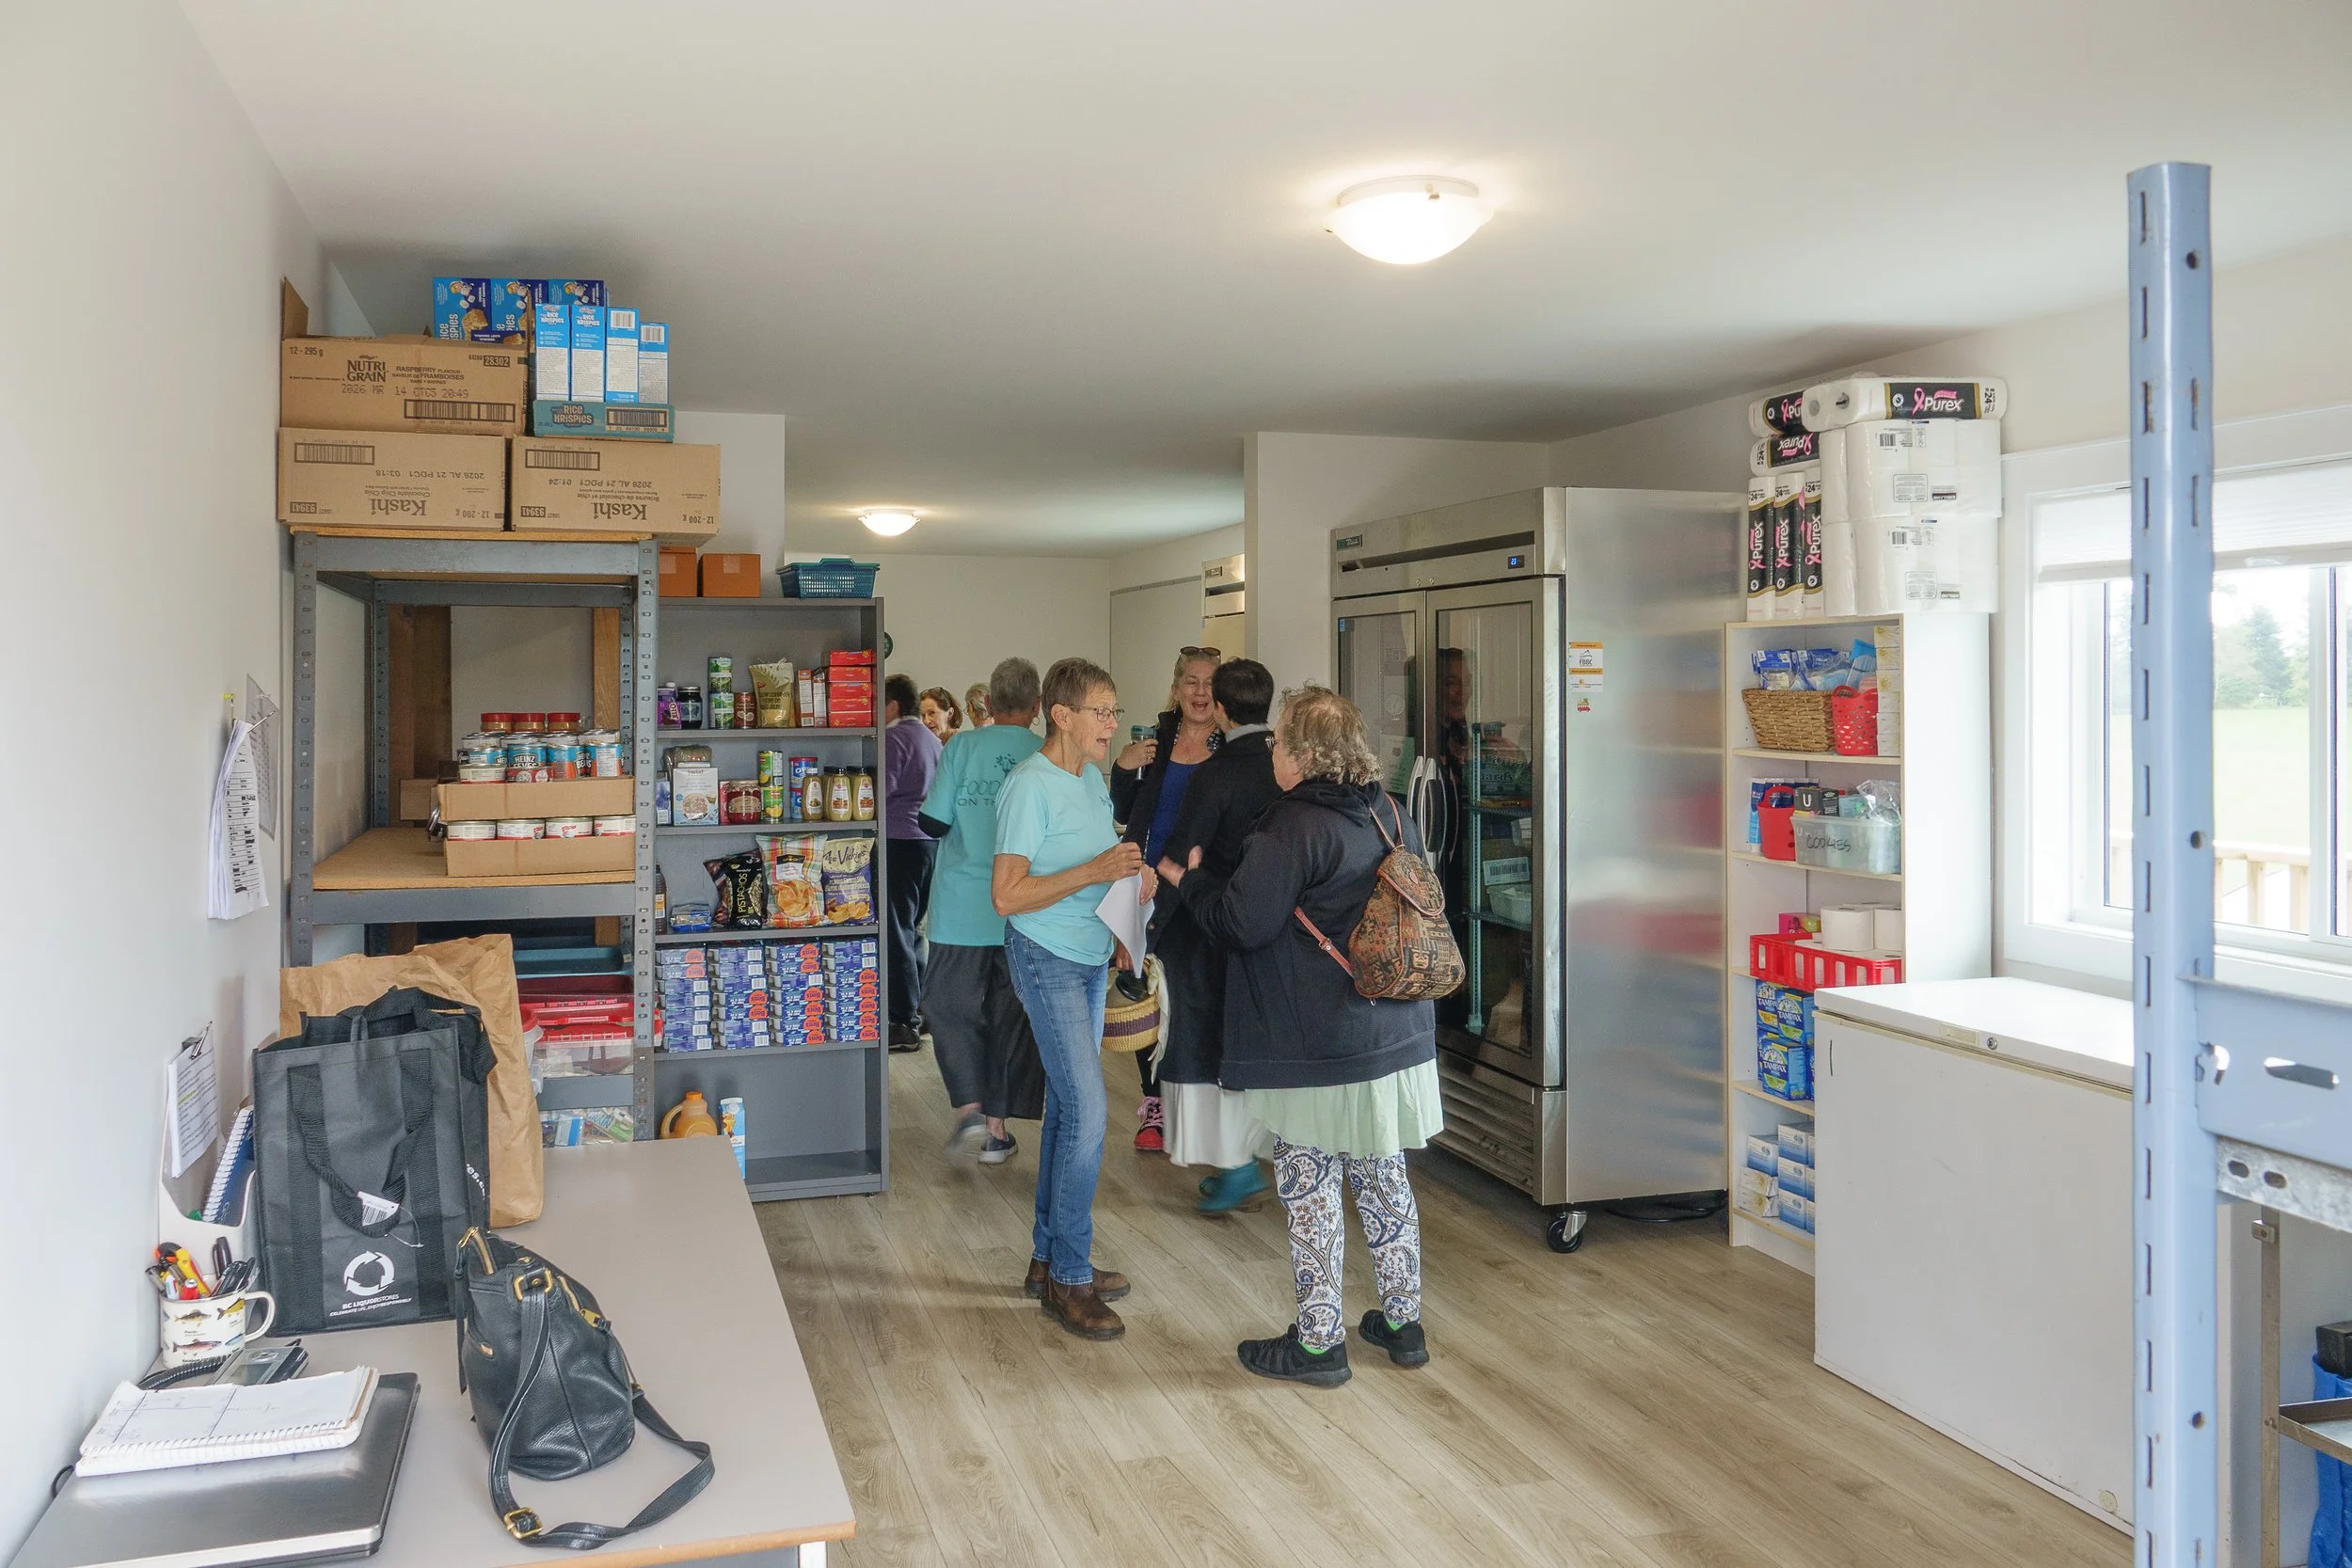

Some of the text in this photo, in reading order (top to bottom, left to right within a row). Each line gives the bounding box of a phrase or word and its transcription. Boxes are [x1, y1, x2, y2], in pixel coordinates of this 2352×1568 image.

[290, 346, 298, 354] 12
[304, 347, 318, 355] 295
[347, 360, 386, 372] NUTRI
[485, 356, 509, 366] 28302
[347, 372, 386, 382] GRAIN
[341, 384, 366, 394] 2026
[1924, 396, 1963, 411] Purex
[1984, 392, 1992, 404] 24
[1777, 436, 1805, 451] Purex
[290, 503, 316, 512] 93941
[372, 498, 426, 516] Kashi
[521, 507, 545, 516] 93941
[593, 503, 647, 520] Kashi
[1753, 521, 1764, 559] Purex
[1779, 518, 1789, 557] Purex
[1810, 515, 1821, 554] Purex
[1803, 794, 1811, 807] U
[1757, 998, 1777, 1008] TAMPA
[1778, 1011, 1802, 1022] TAMPAX
[1763, 1061, 1787, 1073] TAMPAX
